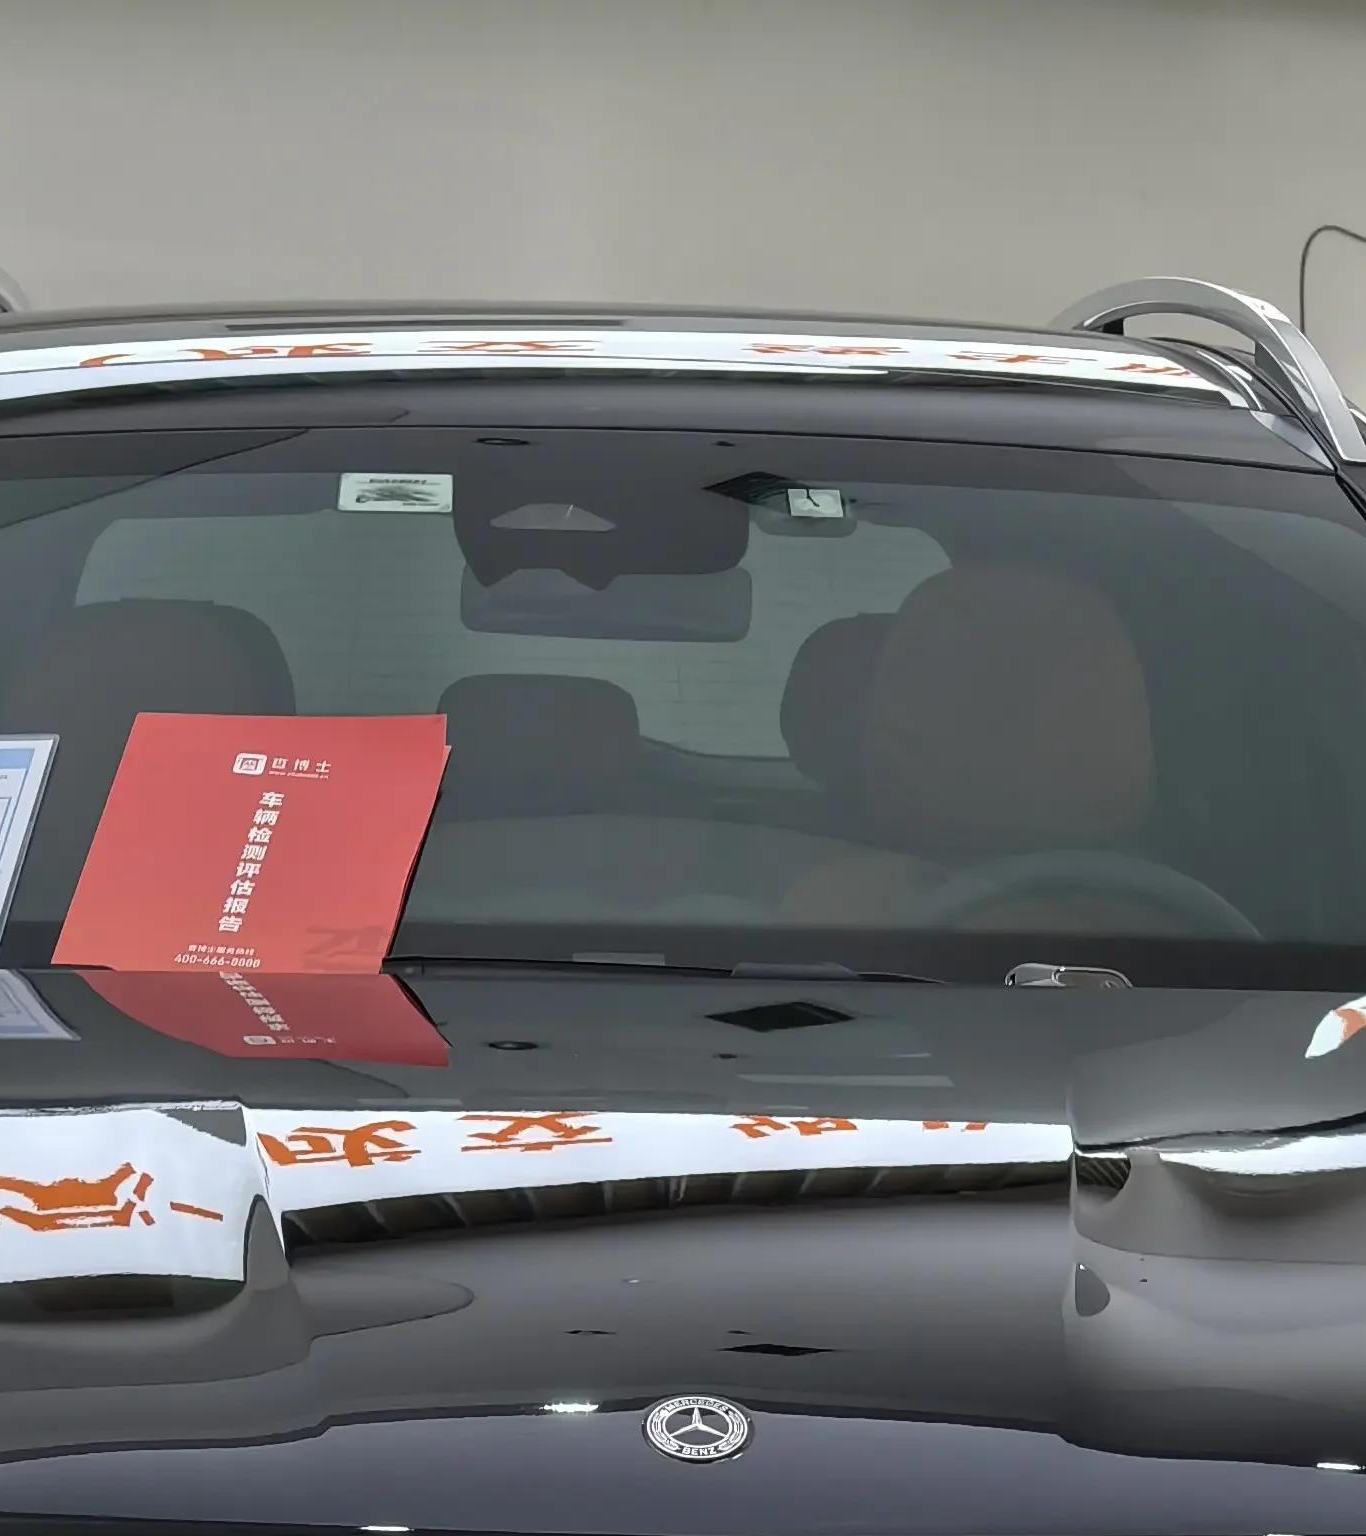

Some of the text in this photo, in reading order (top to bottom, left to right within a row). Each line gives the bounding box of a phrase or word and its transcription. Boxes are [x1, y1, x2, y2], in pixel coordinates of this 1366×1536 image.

[217, 790, 285, 934] 车辆检测评估报告
[173, 953, 262, 968] 400-666-0000
[663, 1398, 729, 1413] MERCEDES
[681, 1446, 718, 1456] BENZ
